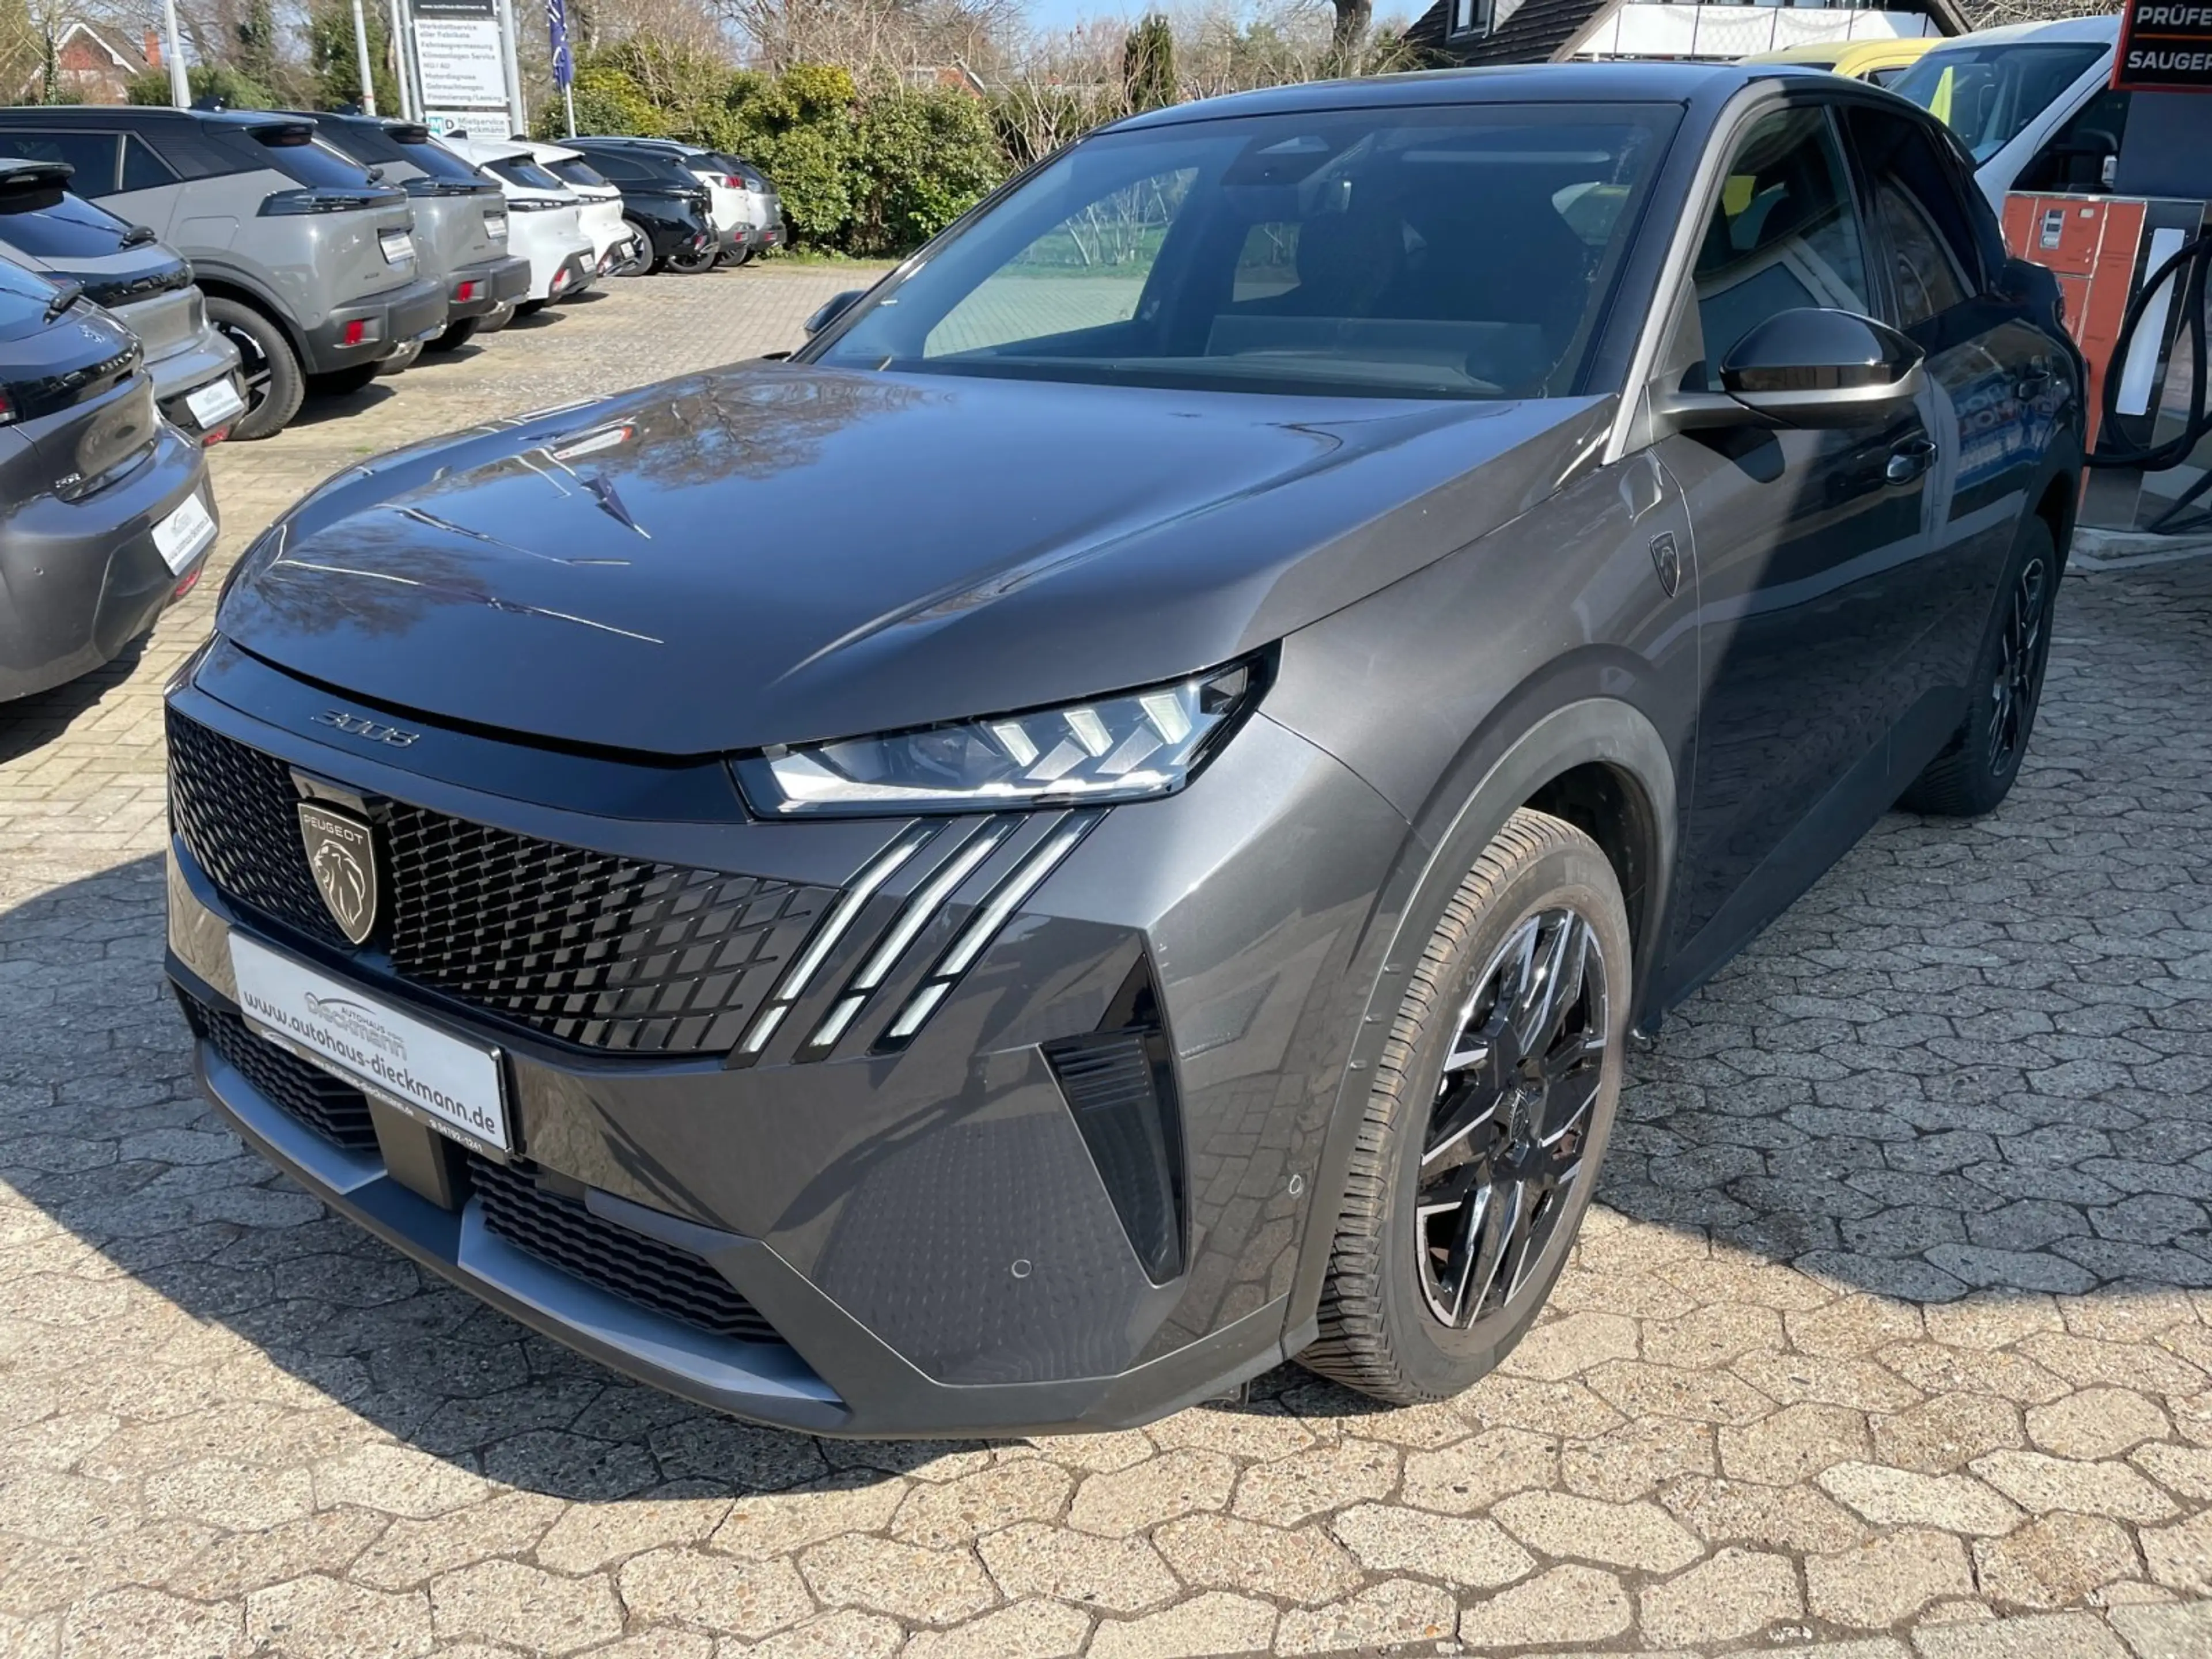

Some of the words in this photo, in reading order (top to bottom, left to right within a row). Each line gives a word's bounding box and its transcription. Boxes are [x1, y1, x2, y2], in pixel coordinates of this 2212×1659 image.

[310, 709, 420, 748] 3008
[303, 813, 363, 845] PEUGEOT
[341, 1006, 385, 1033] AUTOHAUS
[243, 991, 495, 1135] www.autohaus-dieckmann.de
